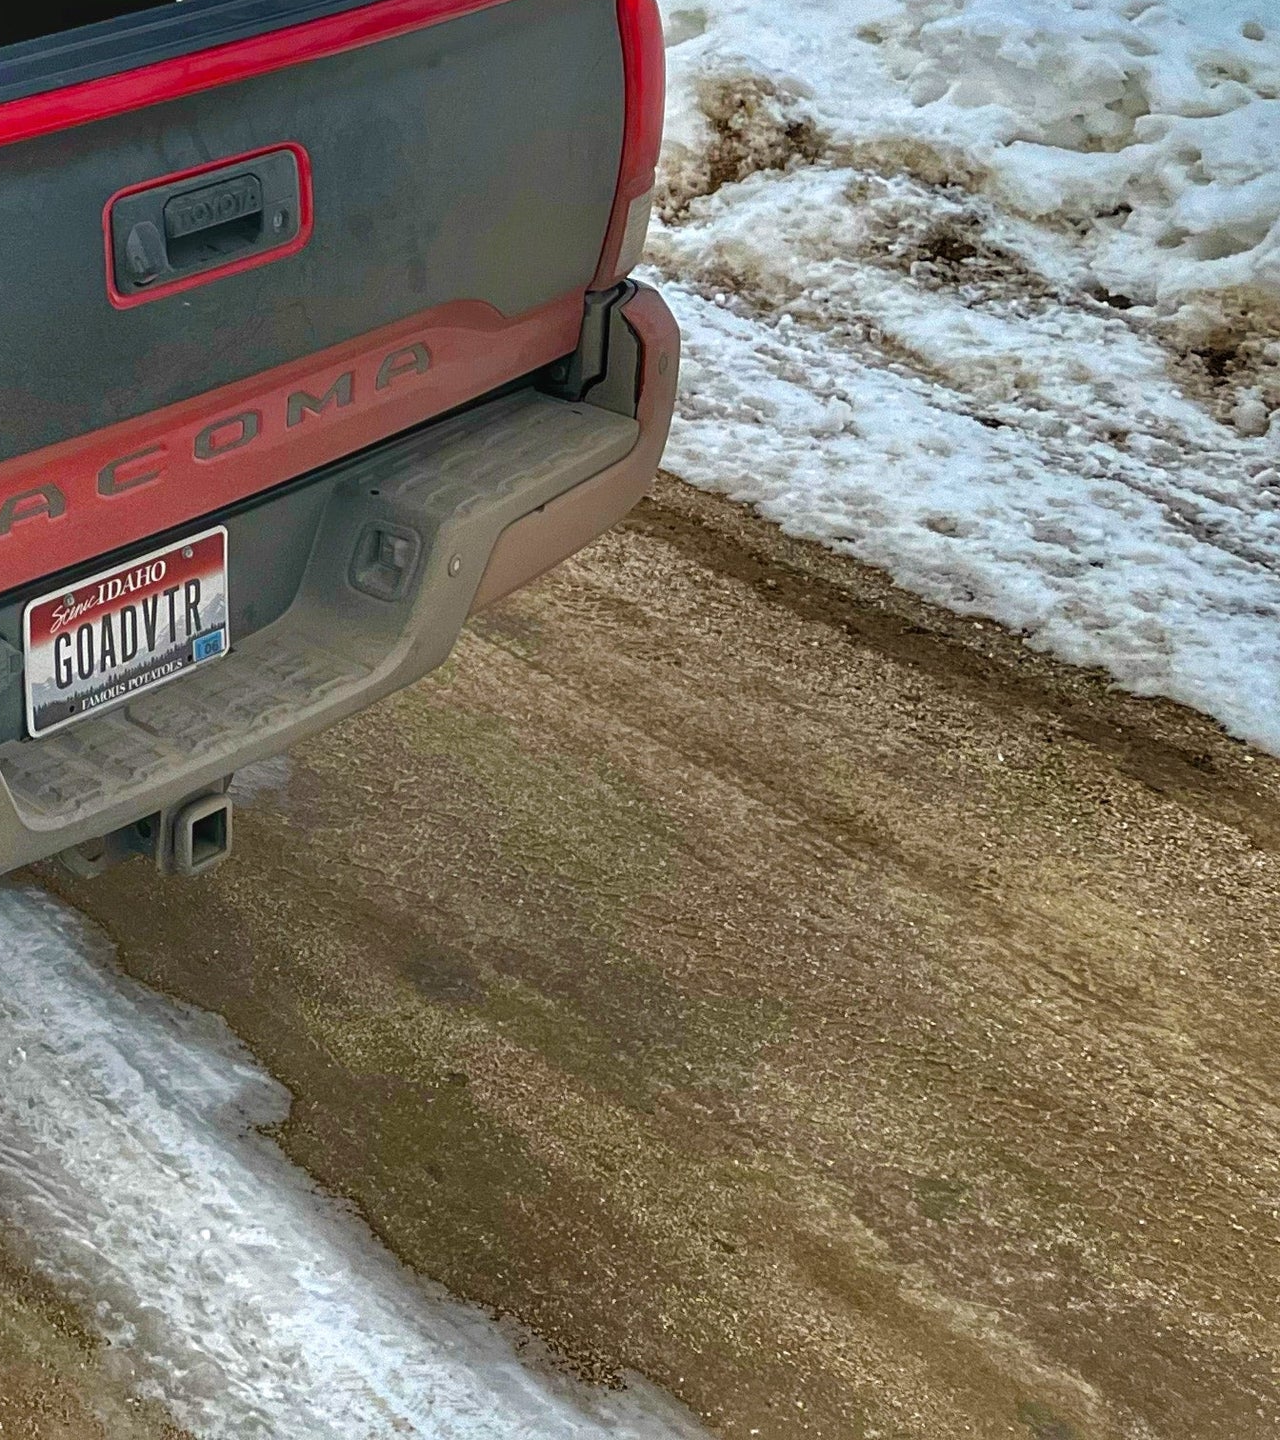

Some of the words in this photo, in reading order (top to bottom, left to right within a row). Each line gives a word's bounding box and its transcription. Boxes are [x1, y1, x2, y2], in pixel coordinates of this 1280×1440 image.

[178, 187, 259, 232] TOYOTA
[50, 594, 99, 634] Scenic
[96, 559, 167, 606] IDAHO
[54, 578, 203, 690] GOADVTR
[81, 682, 126, 711] FAMOUS
[127, 658, 183, 691] POTATOES
